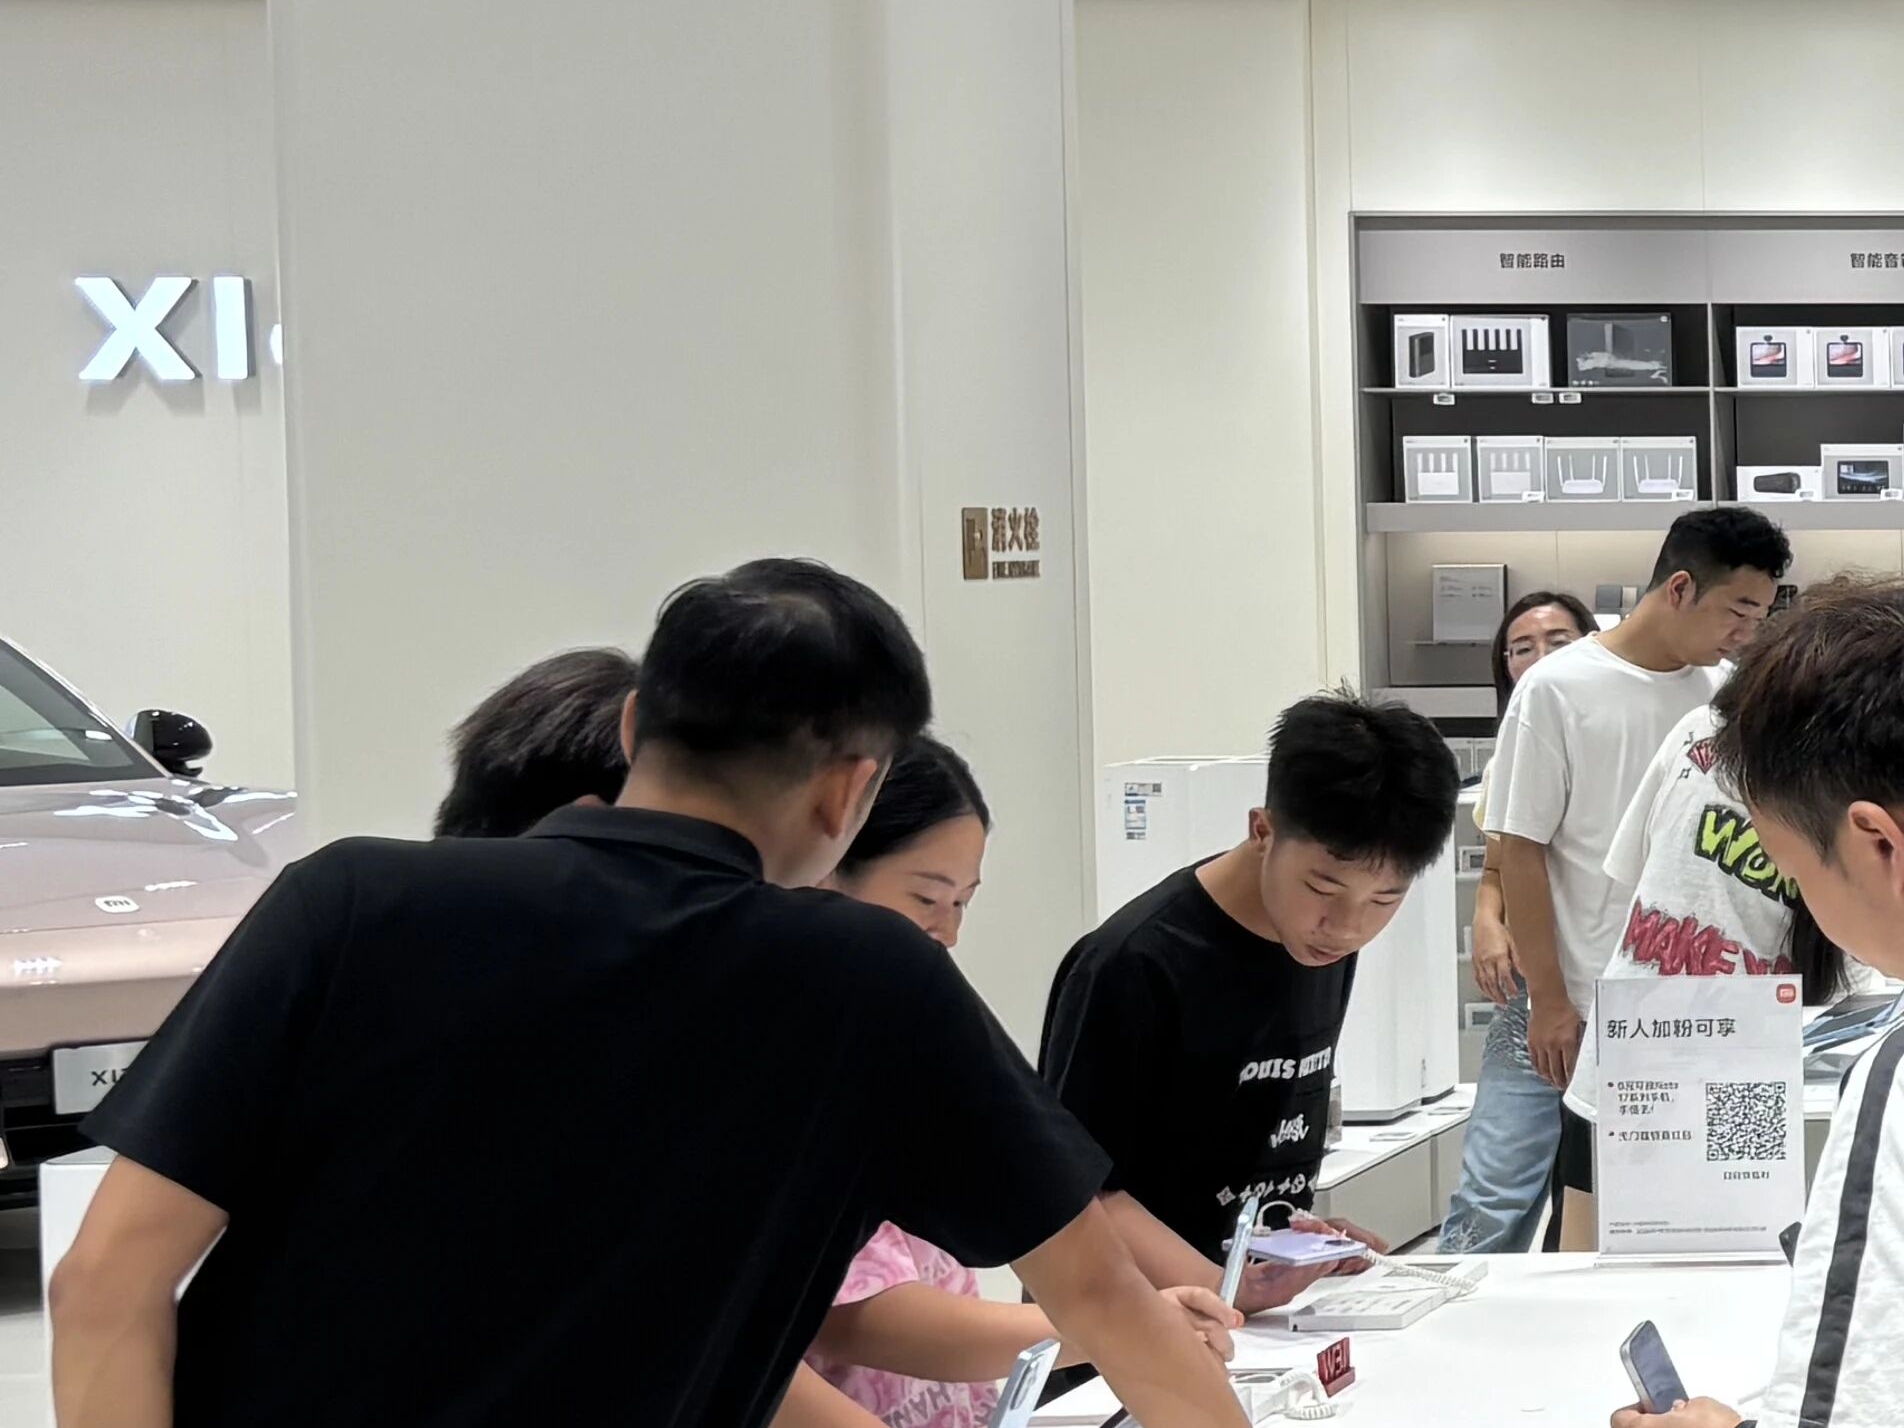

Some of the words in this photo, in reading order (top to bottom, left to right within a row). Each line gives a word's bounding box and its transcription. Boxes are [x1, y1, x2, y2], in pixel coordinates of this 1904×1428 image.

[1499, 252, 1566, 270] 智能路由
[75, 275, 283, 380] XI
[1622, 895, 1742, 976] MAKE
[1239, 1057, 1297, 1083] OUIS
